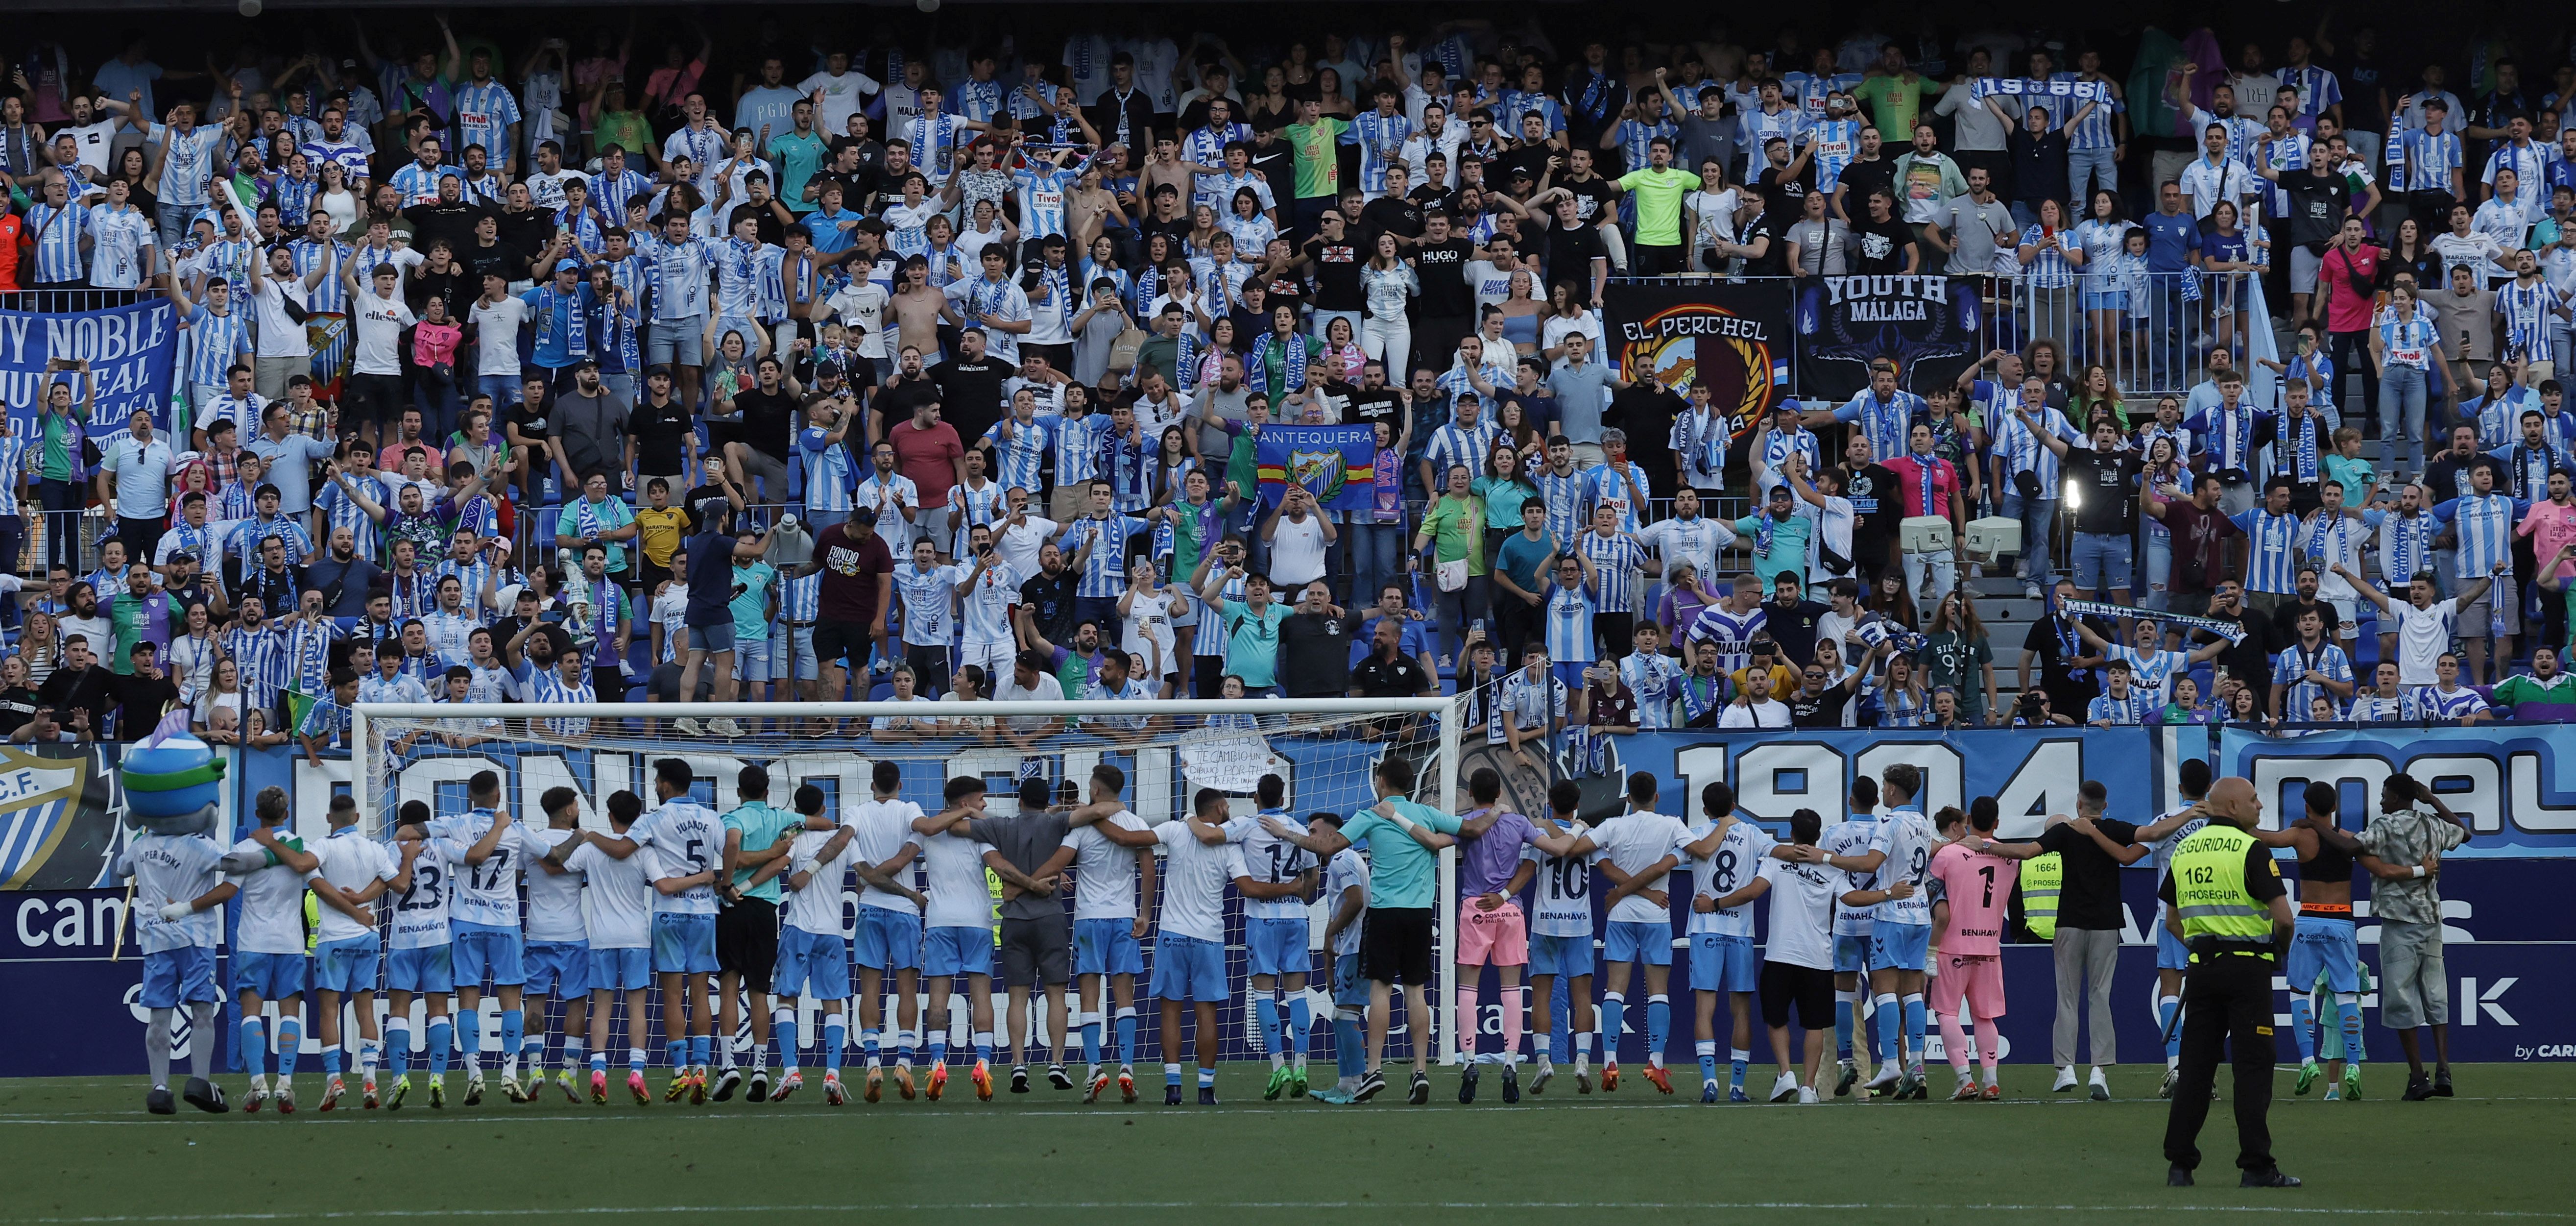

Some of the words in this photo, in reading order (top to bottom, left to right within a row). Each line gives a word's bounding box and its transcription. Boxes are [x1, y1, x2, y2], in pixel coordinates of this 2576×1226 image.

[1983, 88, 2020, 105] 19
[2049, 81, 2095, 98] 86
[462, 113, 486, 123] Tivoli
[1821, 142, 1846, 151] Tivoli
[1036, 194, 1060, 203] Tivoli
[1422, 250, 1457, 260] HUGO
[1825, 274, 1948, 305] YOUTH
[365, 311, 400, 323] ellesse
[1851, 300, 1927, 322] MÁLAGA
[45, 303, 170, 365] NOBLE
[1622, 322, 1654, 342] EL
[1662, 316, 1768, 342] PERCHEL
[2393, 351, 2419, 360] Tivoli
[72, 356, 150, 406] LEAL
[1359, 400, 1392, 411] HOOLIGANS
[1259, 431, 1373, 444] ANTEQUERA
[2308, 420, 2316, 470] CIUDAD
[2468, 510, 2504, 518] MARATHON
[828, 545, 860, 563] FONDO
[826, 557, 843, 574] SUR
[135, 611, 149, 619] má
[606, 605, 615, 623] MUY
[2066, 601, 2133, 618] MALAKA
[132, 618, 149, 626] laga
[1194, 750, 1209, 761] TE
[1224, 765, 1245, 775] POR
[1249, 764, 1262, 775] TU
[1674, 738, 2083, 842] 1904
[676, 823, 708, 834] JUANDE
[2172, 820, 2204, 844] NELSON
[1724, 835, 1744, 846] ANPE
[2175, 838, 2242, 856] SEGURIDAD
[686, 840, 708, 876] 5
[1265, 844, 1301, 883] 14
[1912, 846, 1926, 886] 9
[471, 849, 509, 890] 17
[1713, 850, 1737, 893] 8
[2035, 863, 2057, 873] 1664
[2186, 867, 2214, 884] 162
[1546, 858, 1589, 900] 10
[1979, 865, 1994, 909] 1
[398, 866, 442, 911] 23
[2184, 891, 2240, 901] PROSEGUR
[2514, 1044, 2535, 1058] by
